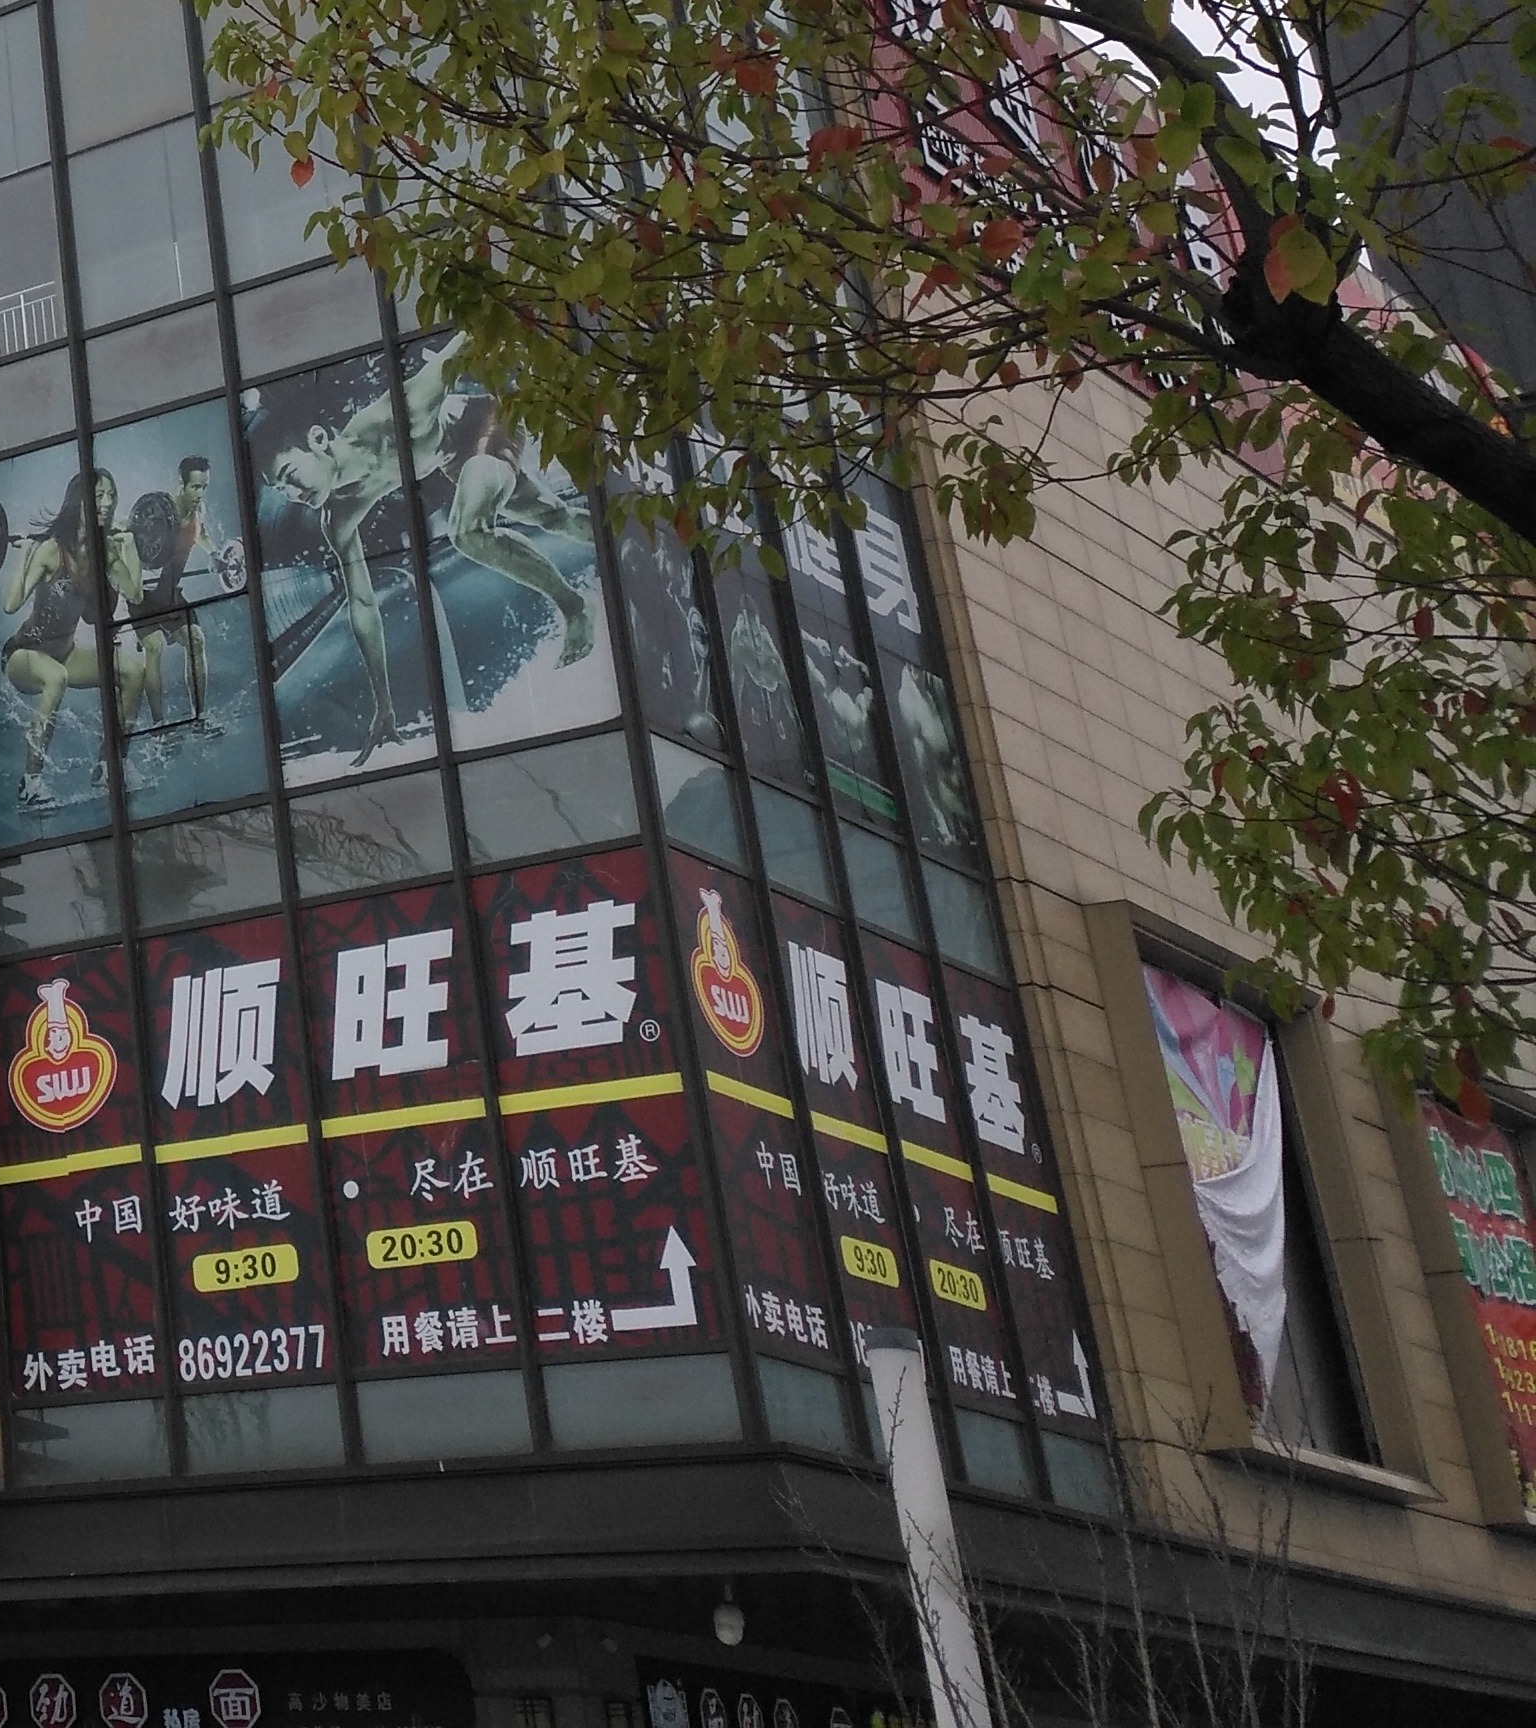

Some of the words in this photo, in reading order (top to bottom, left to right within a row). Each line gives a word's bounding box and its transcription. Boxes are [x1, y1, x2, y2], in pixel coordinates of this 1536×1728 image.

[162, 899, 637, 1110] 顺旺基
[787, 940, 1026, 1156] 顺旺基
[213, 1252, 278, 1286] 9:30
[380, 1227, 465, 1262] 20:30
[853, 1244, 888, 1279] 9:30
[937, 1266, 979, 1304] 20:30
[23, 1334, 156, 1392] 外卖电话
[179, 1324, 326, 1382] 86922377
[382, 1299, 613, 1356] 用餐请上二楼
